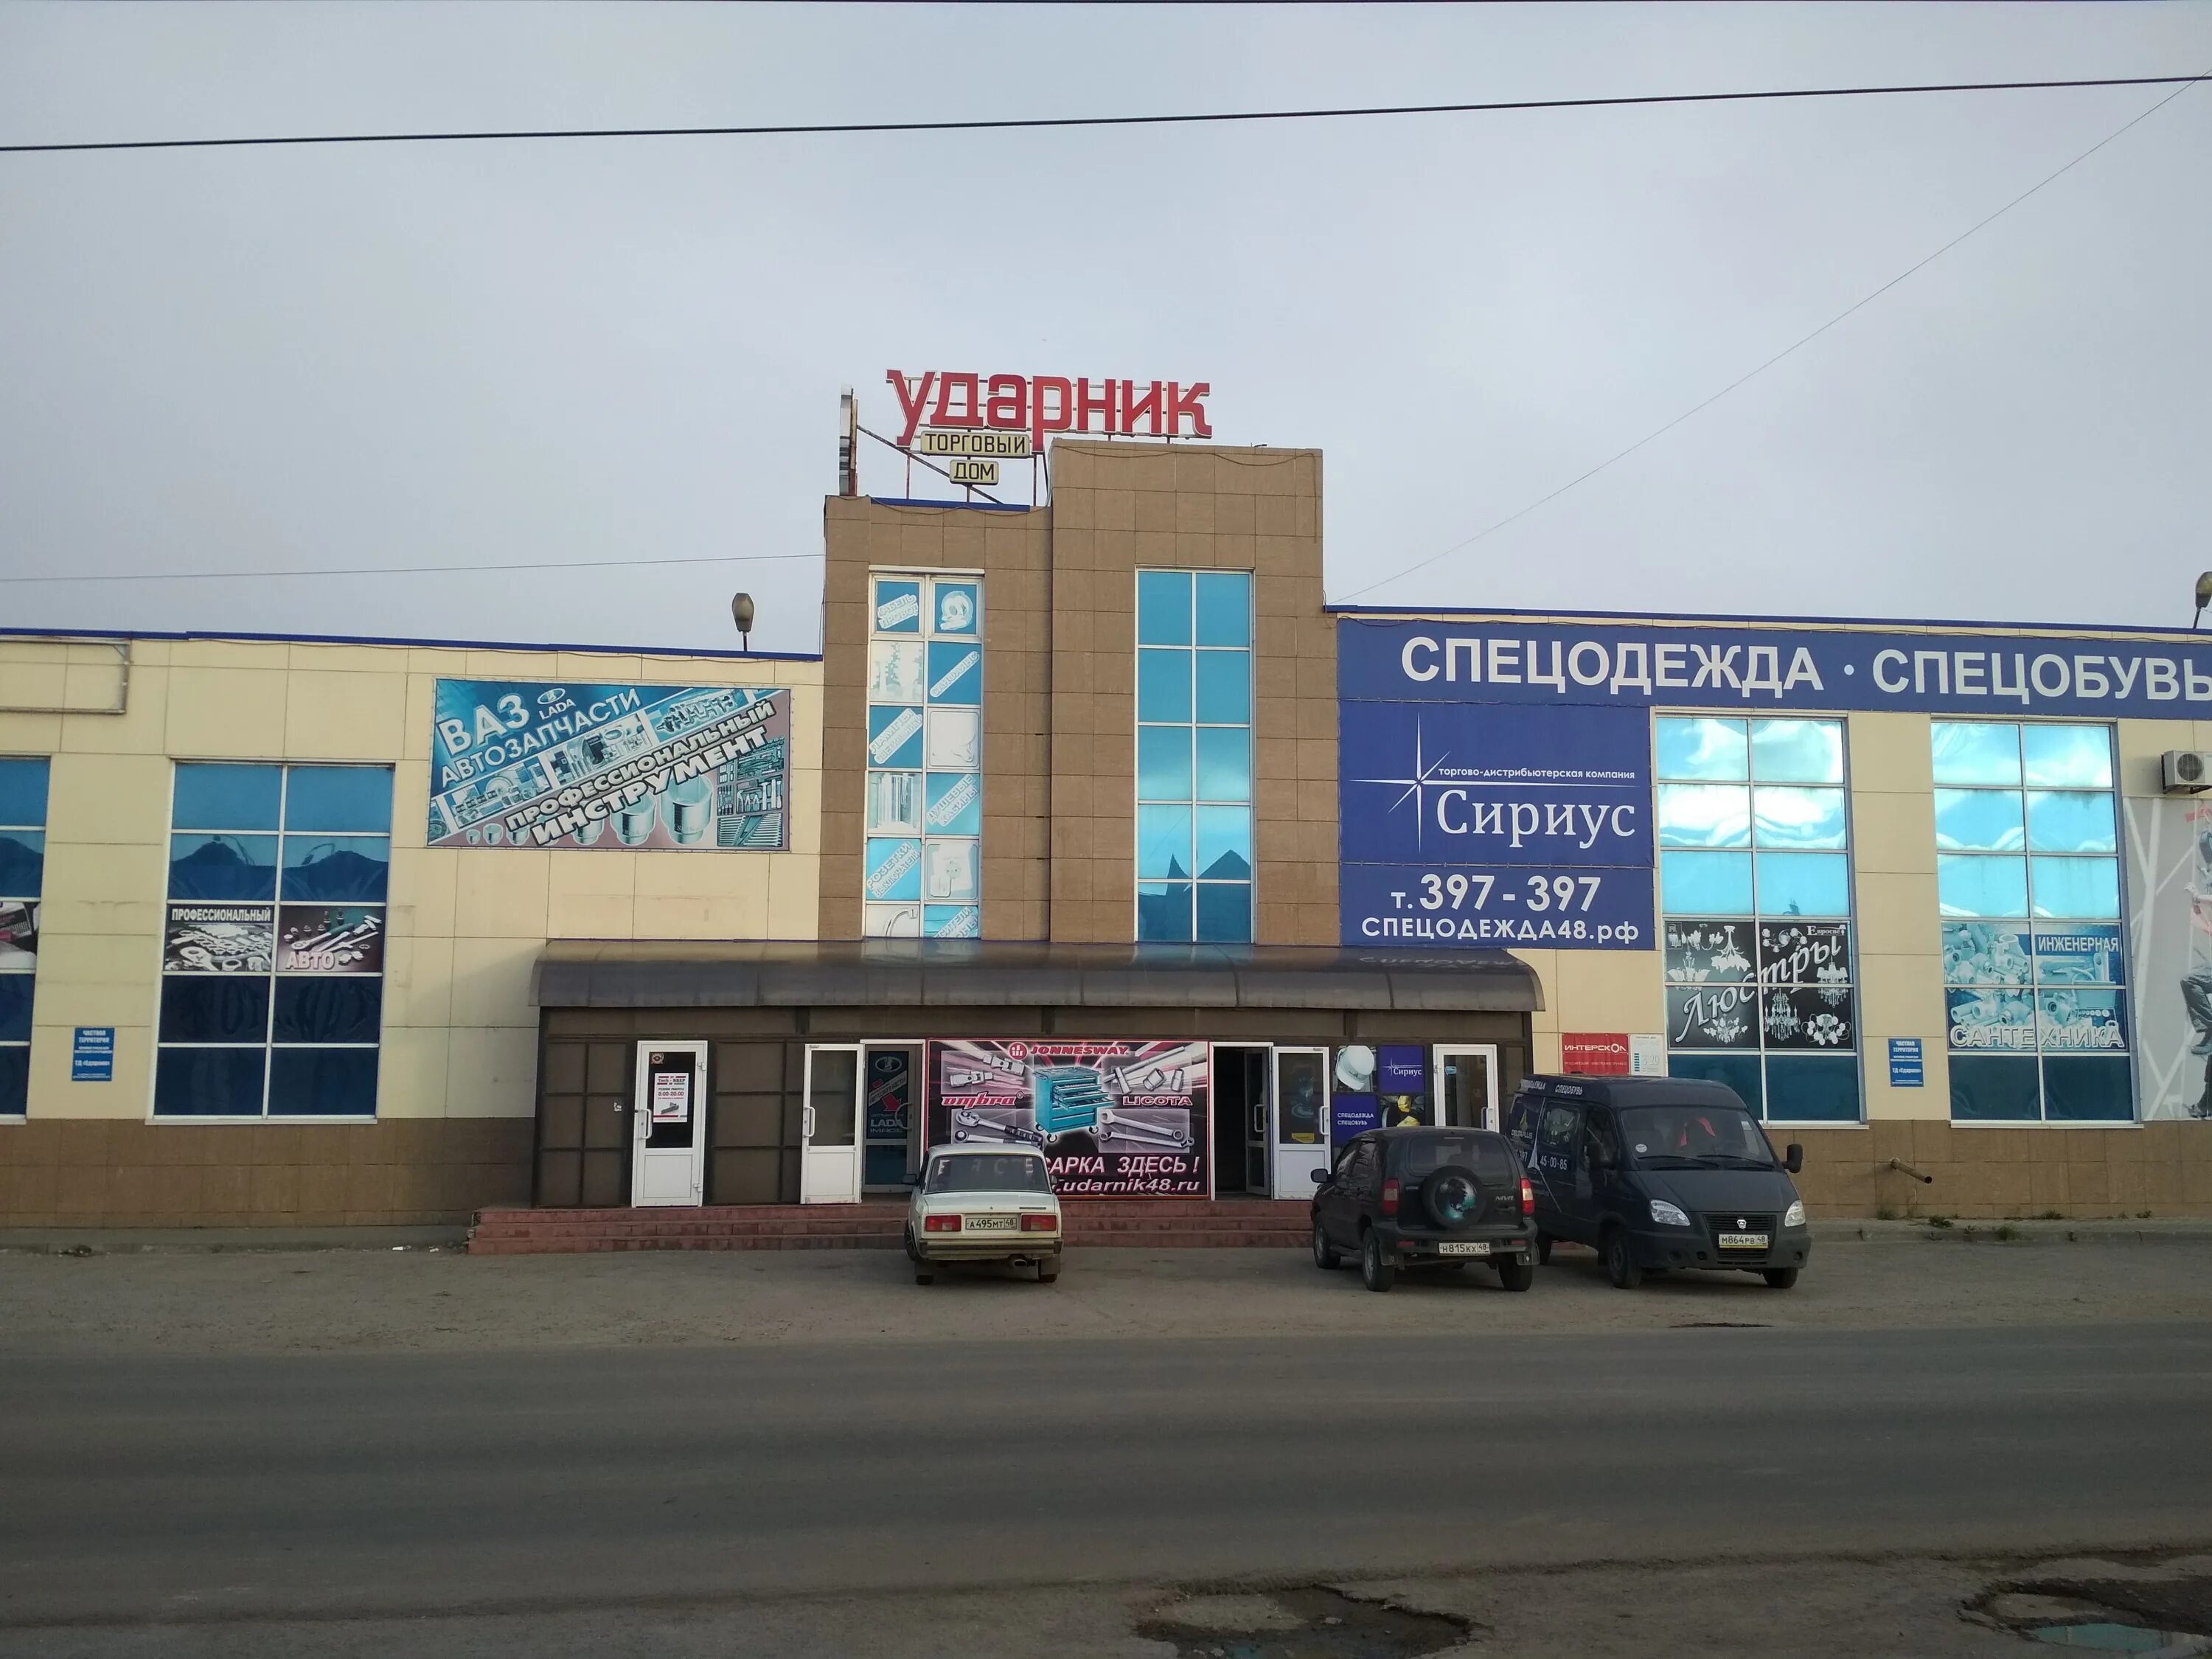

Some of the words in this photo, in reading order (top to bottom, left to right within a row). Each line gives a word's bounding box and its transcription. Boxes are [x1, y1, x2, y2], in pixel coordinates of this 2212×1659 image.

[925, 433, 1026, 453] ТОРГОВЫЙ
[953, 462, 995, 481] ДОМ
[1402, 636, 1824, 698] СПЕЦОДЕЖДА
[1873, 649, 2212, 704] СПЕЦОБУВЬ
[538, 697, 577, 720] LADA
[437, 694, 529, 757] ВАЗ
[440, 688, 642, 789] АВТОЗАПЧАСТИ
[505, 698, 776, 832] ПРОФЕССИОНАЛЬНЫЙ
[1438, 768, 1584, 779] торгово-дистрибьютерская
[1585, 768, 1635, 780] компания
[529, 725, 768, 847] ИНСТРУМЕНТ
[1437, 789, 1635, 849] Сириус
[866, 841, 914, 889] РОЗЕТКИ
[171, 907, 271, 921] ПРОФЕССИОНАЛЬНЫЙ
[1361, 917, 1639, 944] СПЕЦОДЕЖДА48.рф
[2038, 936, 2119, 952] ИНЖЕНЕРНАЯ
[285, 951, 335, 970] АВТО
[1674, 936, 1842, 1043] Люстры
[1950, 1024, 2125, 1048] САНТЕХНИКА
[1031, 1046, 1130, 1055] JONNESWAY
[1564, 1043, 1627, 1053] ИНТЕРСКОЛ
[1393, 1068, 1422, 1077] Сириус
[1123, 1096, 1193, 1106] LICOTA
[1555, 1084, 1583, 1096] СПЕЦОБУВЬ
[1117, 1156, 1186, 1178] ЗДЕСЬ
